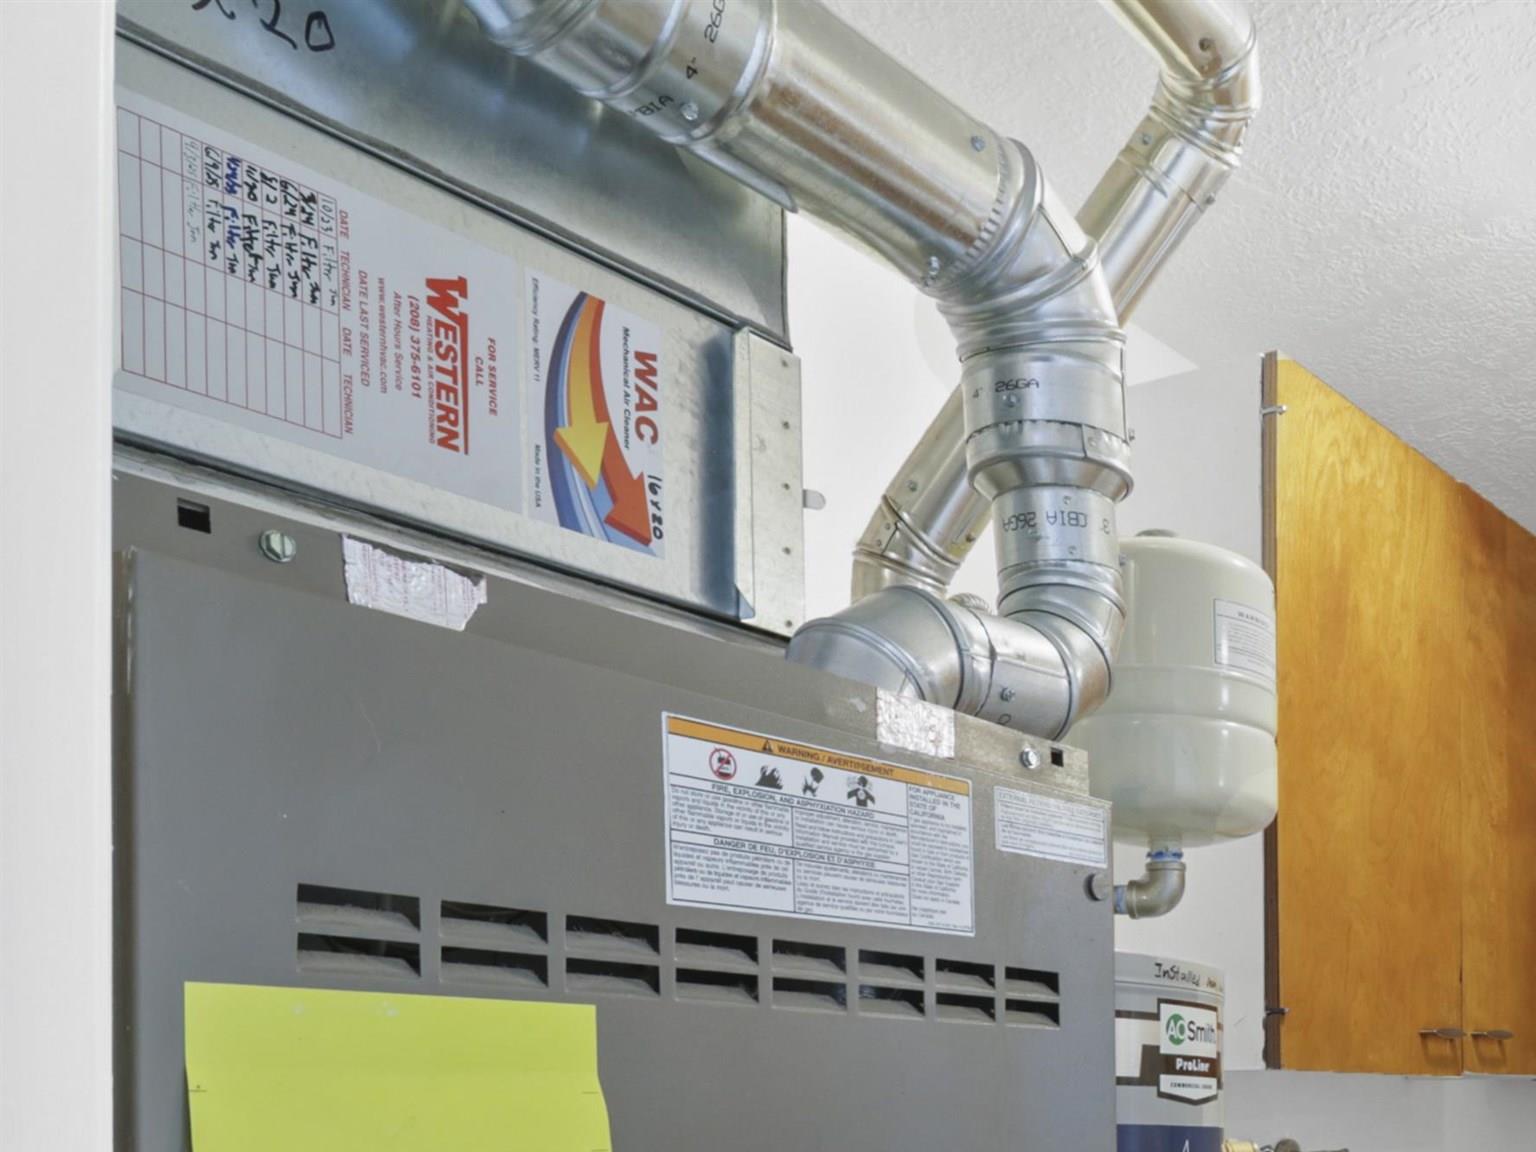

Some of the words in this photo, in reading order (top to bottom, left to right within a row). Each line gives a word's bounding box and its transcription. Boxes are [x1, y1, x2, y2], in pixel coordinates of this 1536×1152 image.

[339, 209, 350, 239] DATE
[340, 251, 351, 311] TECHNICIAN
[358, 270, 369, 299] DATE
[531, 277, 539, 316] Efficiency
[359, 300, 369, 330] LAST
[393, 291, 402, 317] After
[407, 295, 420, 332] (208)
[342, 327, 352, 356] DATE
[378, 278, 388, 393] www.westernhvac.com
[393, 319, 402, 350] Hours
[426, 315, 434, 353] HEATING
[487, 337, 497, 362] FOR
[359, 332, 370, 387] SERVICED
[394, 352, 404, 391] Service
[410, 336, 422, 398] 375-6101
[427, 278, 469, 451] WESTERN
[475, 356, 484, 386] CALL
[622, 327, 630, 388] Mechanical
[488, 365, 498, 415] SERVICE
[623, 390, 631, 406] Air
[630, 349, 659, 447] WAC
[994, 378, 1041, 393] 26GA
[343, 375, 353, 434] TECHNICIAN
[623, 408, 631, 450] Cleaner
[534, 490, 542, 508] USA
[778, 745, 820, 761] WARNING
[1187, 1020, 1217, 1044] Smith
